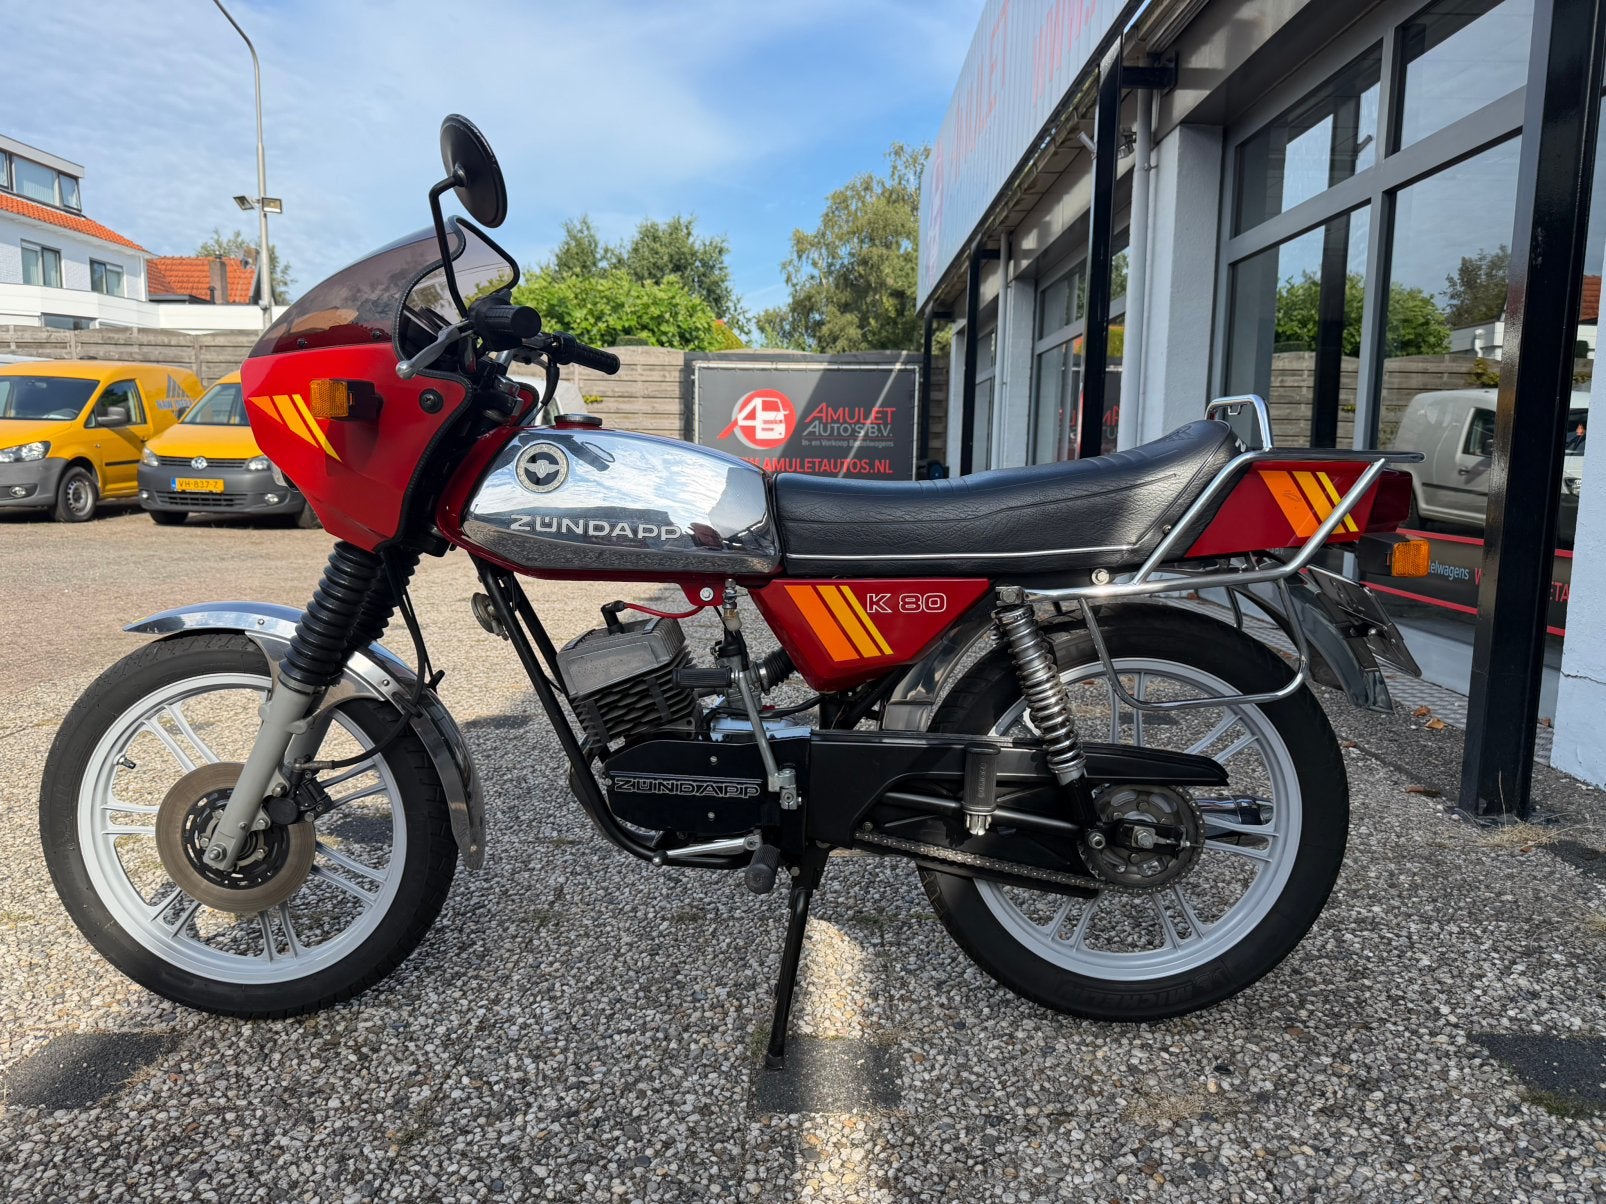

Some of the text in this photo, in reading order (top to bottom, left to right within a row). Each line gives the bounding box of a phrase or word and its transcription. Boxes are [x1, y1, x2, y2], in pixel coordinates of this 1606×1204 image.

[804, 403, 896, 424] AMULET
[802, 420, 893, 437] AUTO'S B.V.
[1428, 562, 1470, 581] elwagens
[867, 593, 947, 613] K 80
